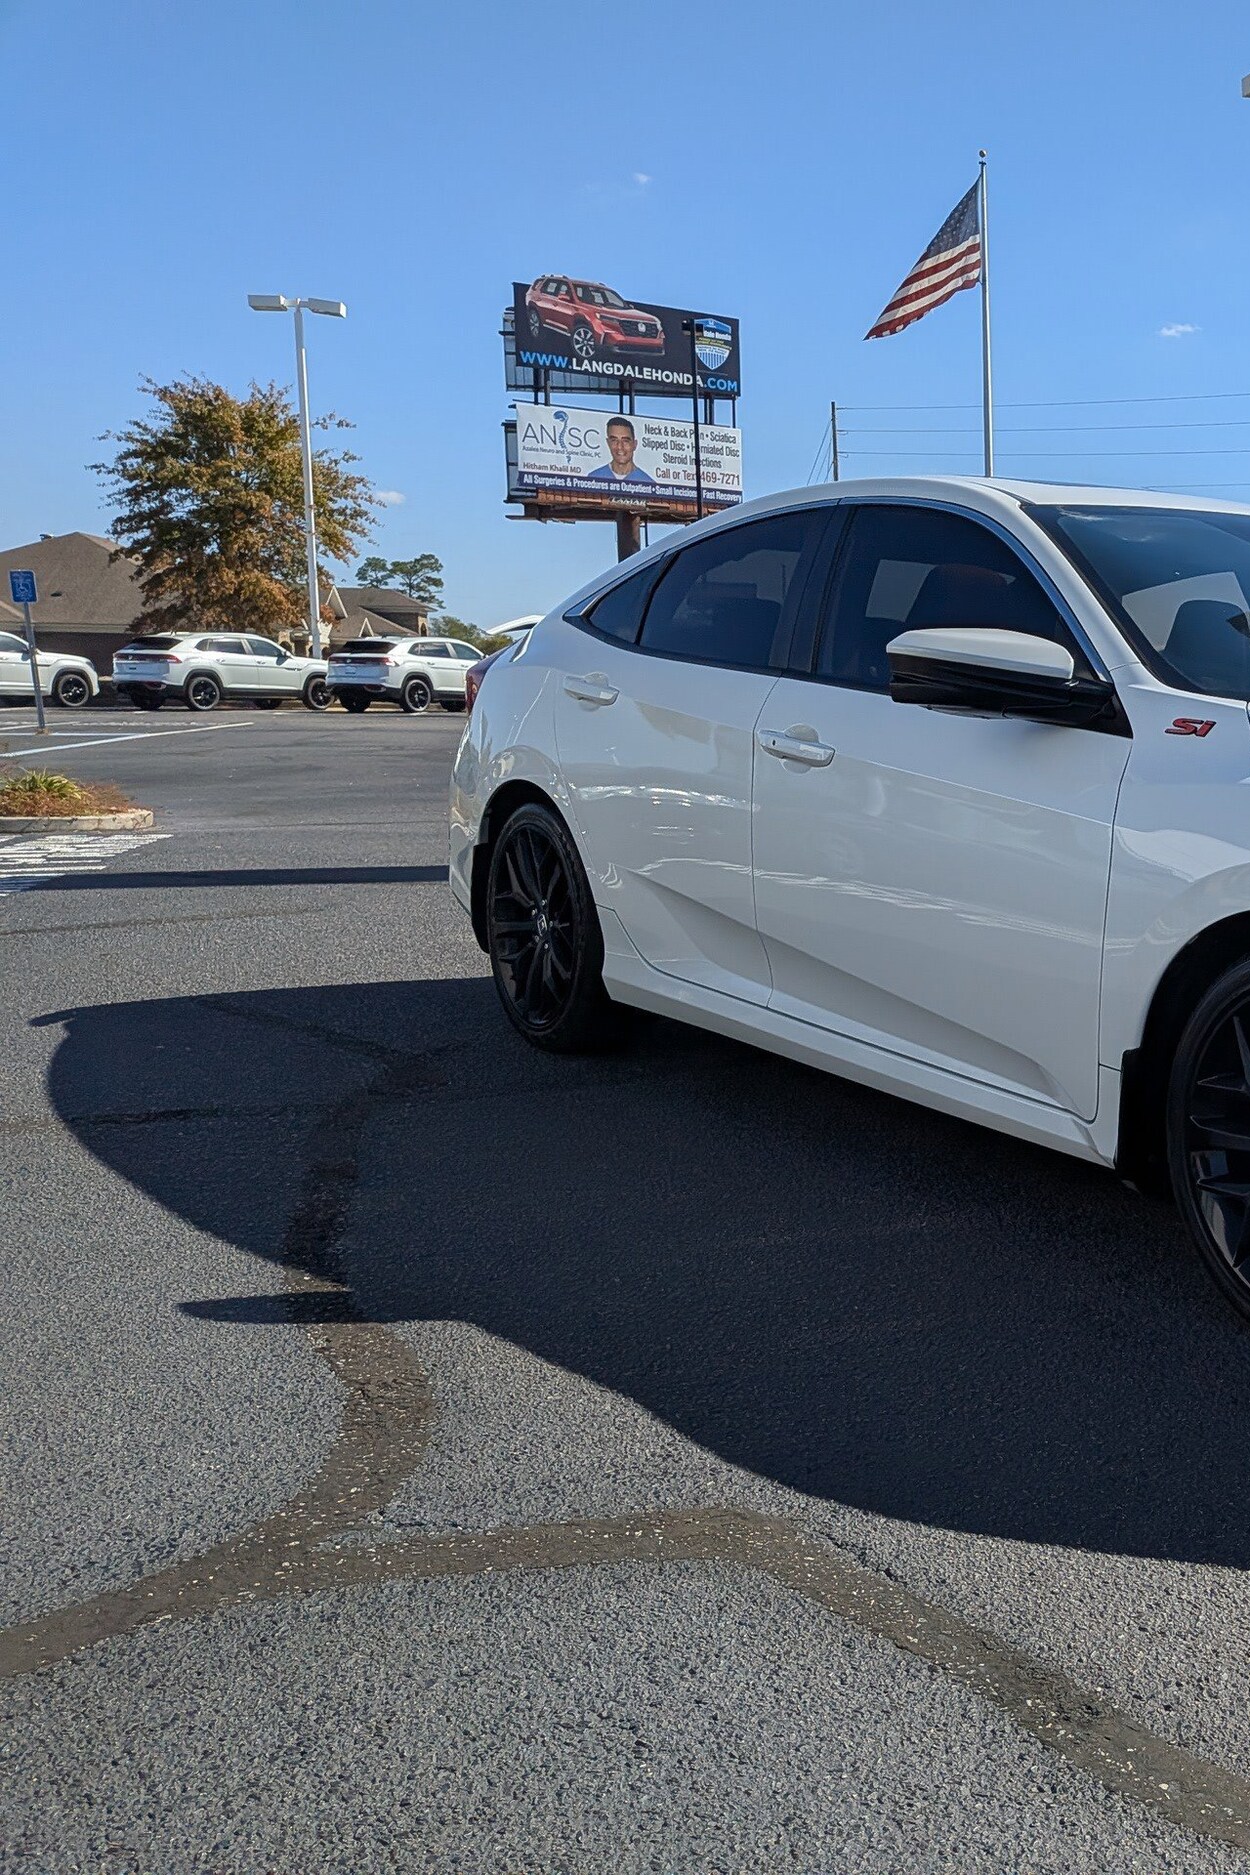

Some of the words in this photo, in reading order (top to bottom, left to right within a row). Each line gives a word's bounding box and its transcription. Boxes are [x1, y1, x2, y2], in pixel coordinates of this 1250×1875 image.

[520, 350, 738, 392] WWW.LANGDALEHONDA.COM
[644, 424, 662, 436] Neck
[664, 426, 669, 436] &
[671, 427, 688, 438] Back
[689, 430, 704, 440] Pn
[710, 431, 736, 444] Sciatica
[642, 437, 668, 451] Slipped
[670, 441, 685, 451] Disc
[691, 442, 724, 456] Hrniated
[725, 446, 740, 457] Disc
[523, 462, 548, 470] Hitham
[550, 464, 568, 472] Khalil
[663, 453, 687, 465] Steroid
[689, 456, 722, 468] Inctions
[656, 467, 670, 479] Call
[672, 471, 680, 479] or
[682, 470, 697, 480] Tex
[523, 474, 533, 484] All
[534, 475, 565, 487] Surgeries
[566, 478, 572, 486] &
[573, 479, 609, 490] Procedures
[621, 482, 652, 493] Outpatient
[655, 484, 672, 495] Small
[674, 488, 698, 498] Incision
[703, 490, 715, 499] Fast
[716, 491, 742, 503] Recovery
